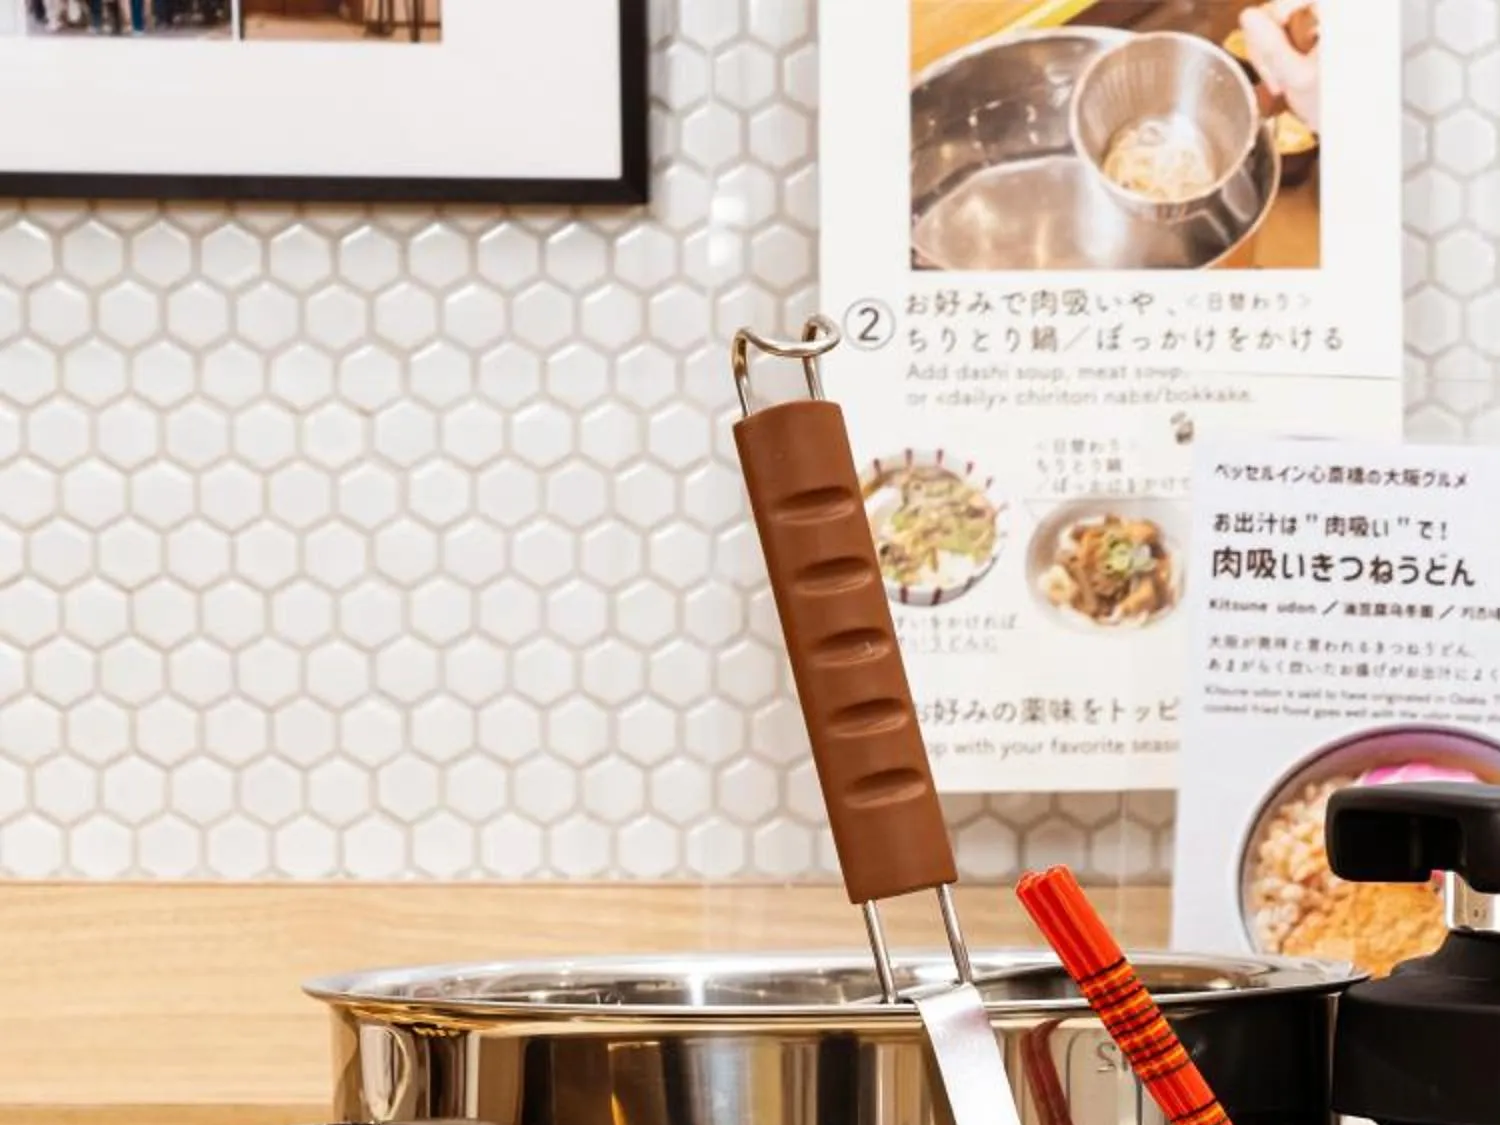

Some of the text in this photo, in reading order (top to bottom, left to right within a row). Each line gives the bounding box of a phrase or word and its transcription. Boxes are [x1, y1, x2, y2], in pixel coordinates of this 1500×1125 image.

[1214, 462, 1470, 488] ベッセルイン心斎橋の大阪グルメ
[1211, 548, 1476, 587] 肉吸いきつねうどん
